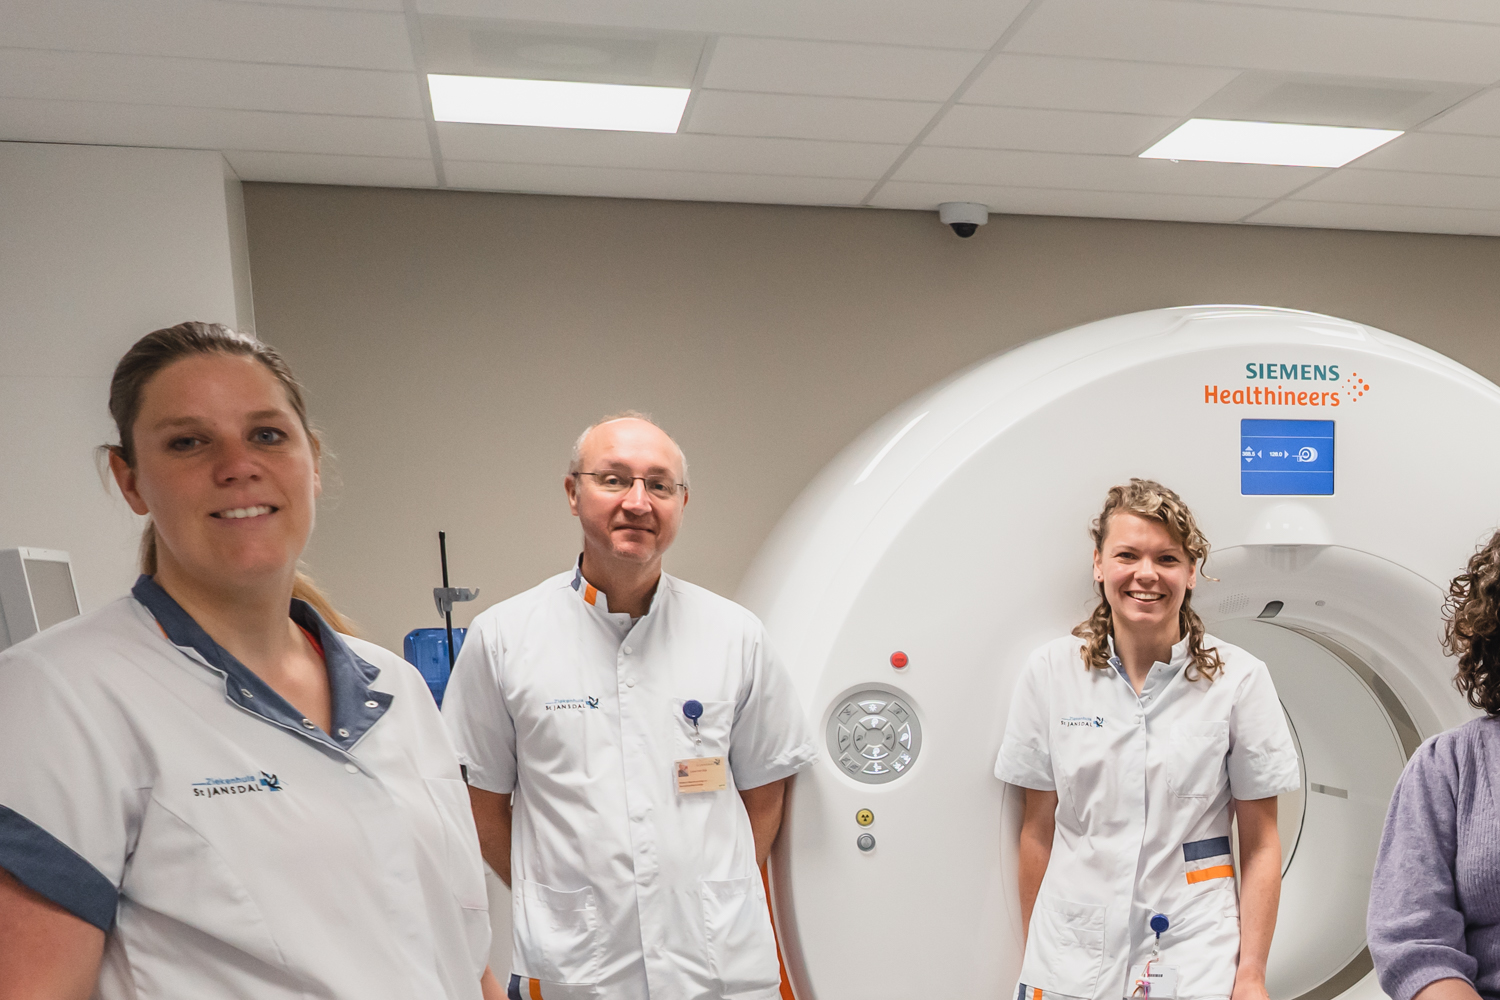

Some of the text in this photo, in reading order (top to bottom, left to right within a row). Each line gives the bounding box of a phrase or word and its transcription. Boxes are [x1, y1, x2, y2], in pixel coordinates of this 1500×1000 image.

[1245, 362, 1340, 381] SIEMENS
[1204, 384, 1340, 407] Healthineers
[193, 784, 263, 798] St JANSDAL
